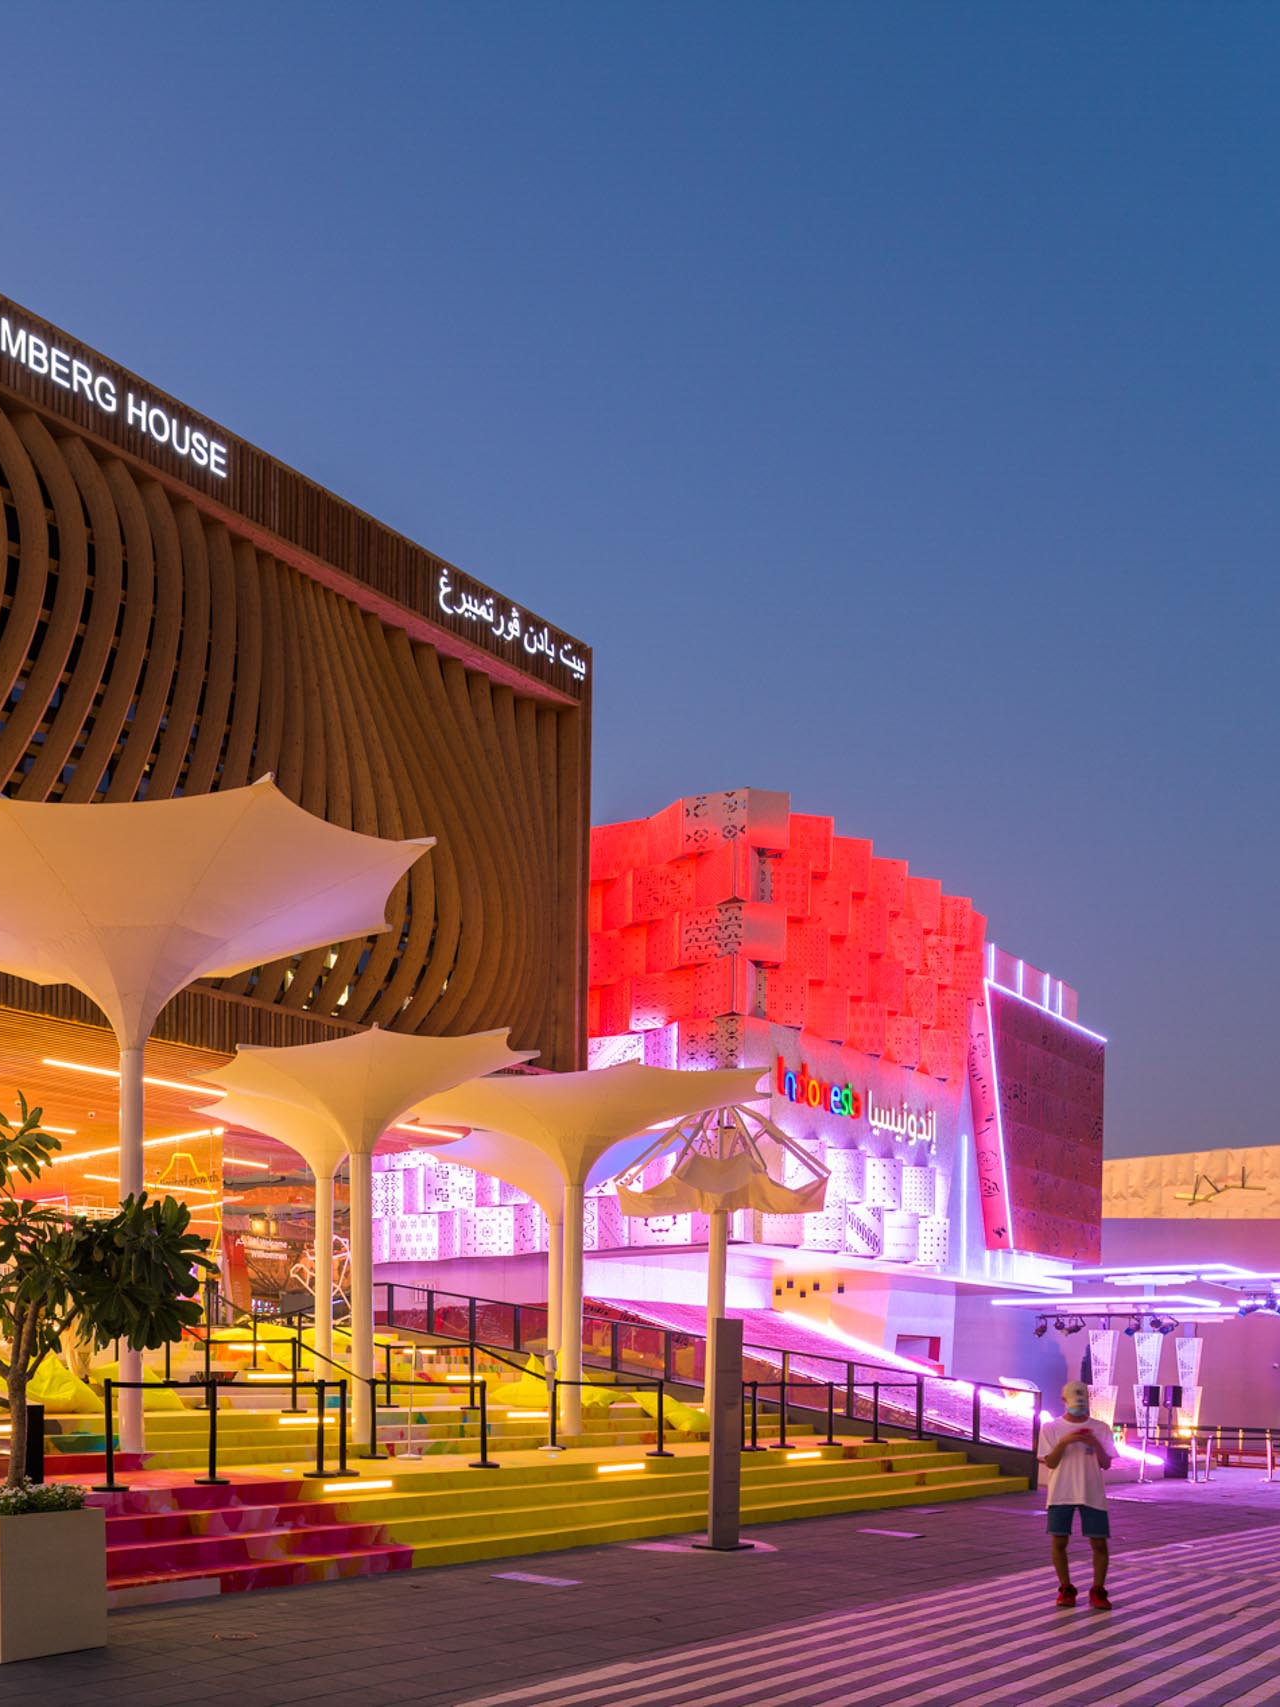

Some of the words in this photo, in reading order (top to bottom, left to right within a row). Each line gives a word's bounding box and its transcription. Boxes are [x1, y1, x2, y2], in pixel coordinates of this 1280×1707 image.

[127, 392, 227, 478] HOUSE
[523, 626, 555, 664] بادن
[559, 643, 586, 681] بيت
[776, 1055, 862, 1120] Indonesia
[867, 1089, 937, 1155] إندونيسيا
